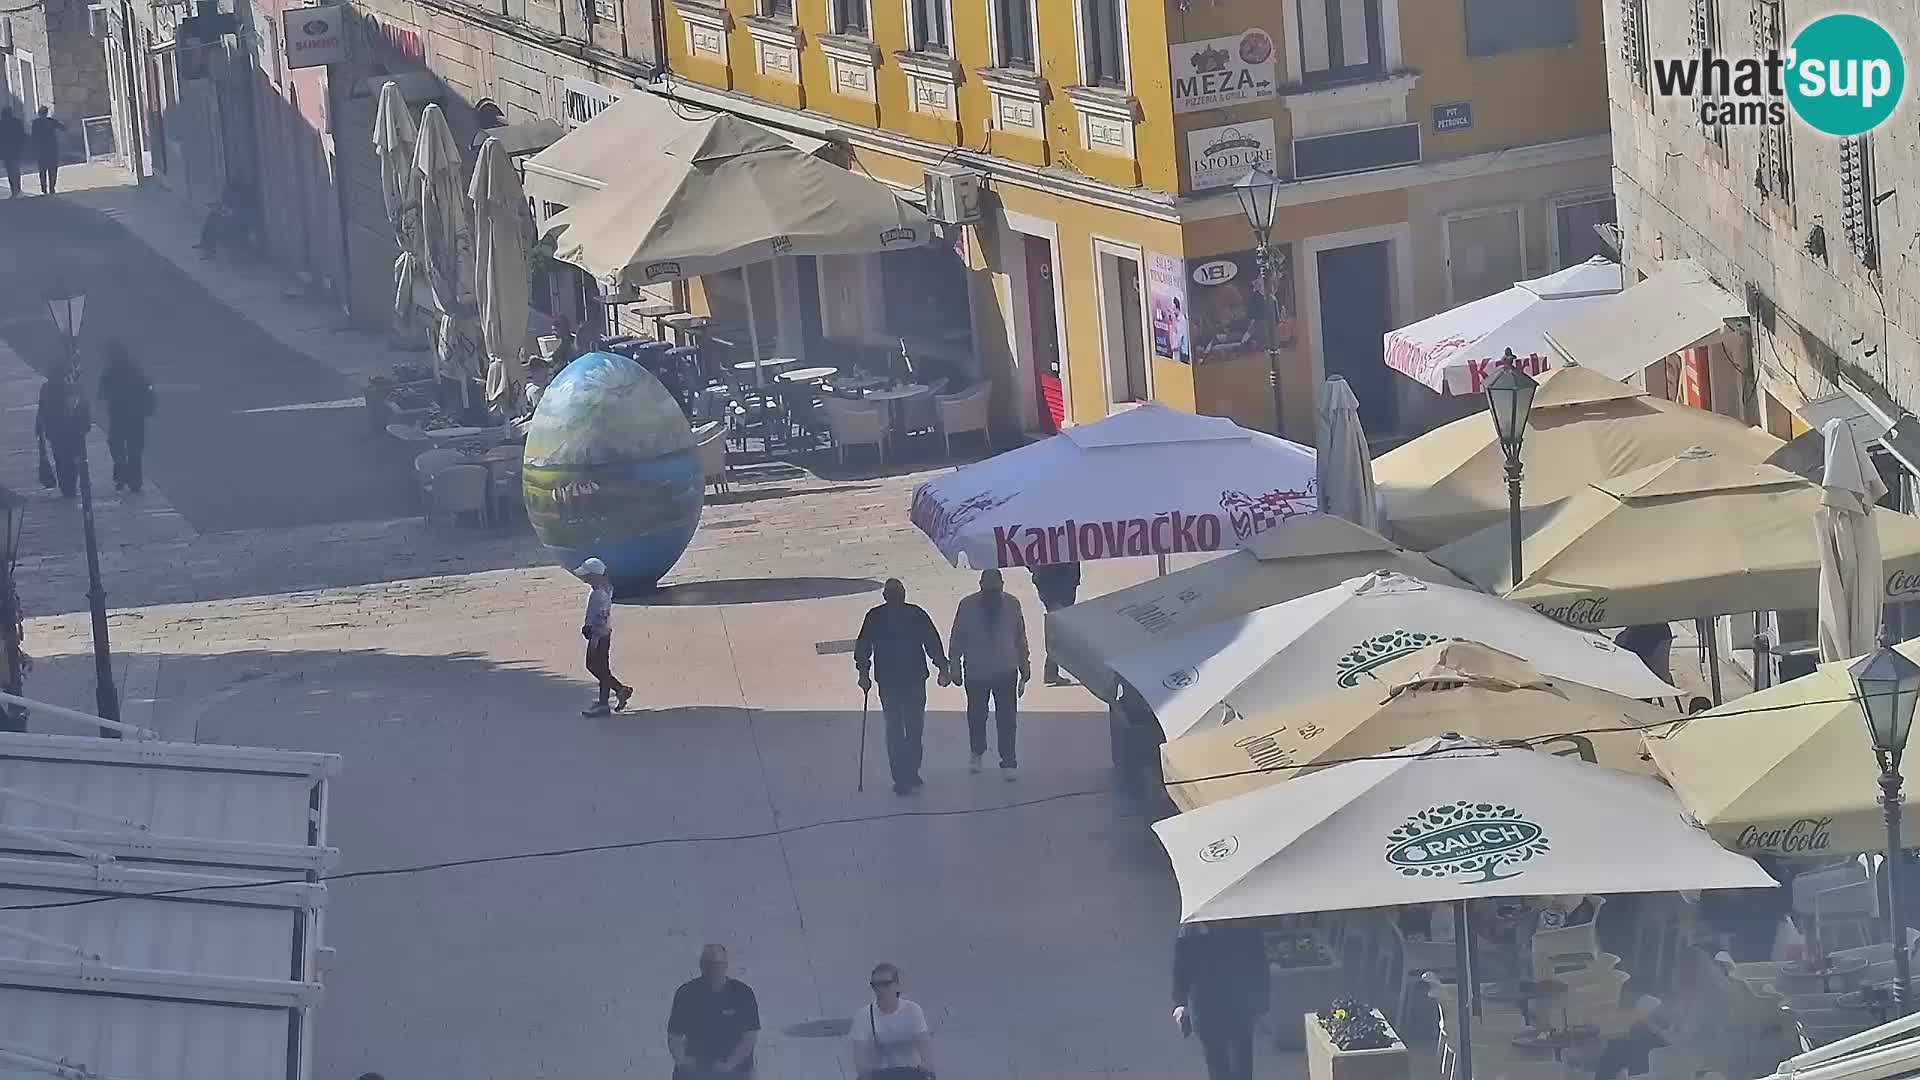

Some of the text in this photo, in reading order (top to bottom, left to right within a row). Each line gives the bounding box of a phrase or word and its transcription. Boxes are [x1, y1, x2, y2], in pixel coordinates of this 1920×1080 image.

[1176, 68, 1254, 98] MEZA
[1185, 93, 1218, 106] PIZZERIA
[1194, 153, 1240, 173] ISPOD
[993, 510, 1222, 569] Karlovačko
[1426, 825, 1525, 857] RAUCH
[1736, 816, 1833, 852] Coca-Cola
